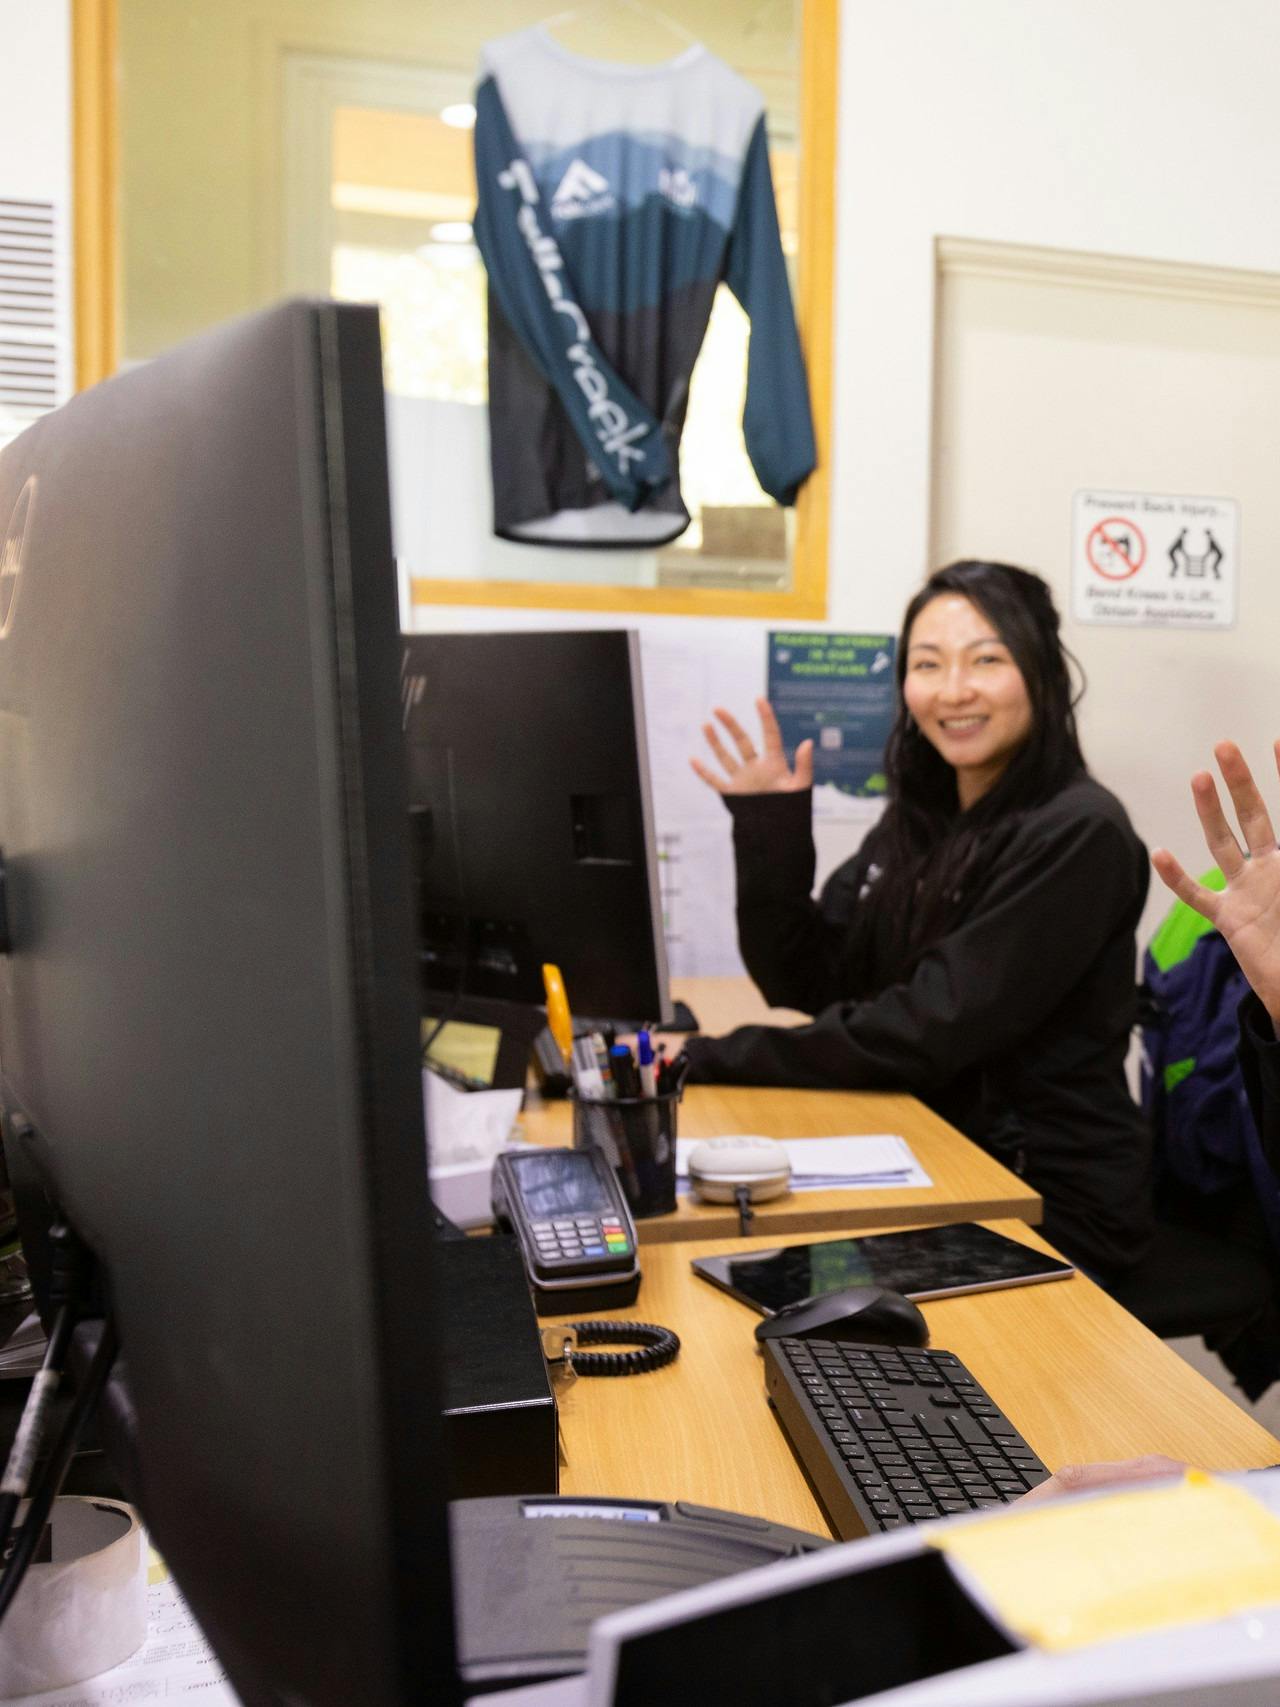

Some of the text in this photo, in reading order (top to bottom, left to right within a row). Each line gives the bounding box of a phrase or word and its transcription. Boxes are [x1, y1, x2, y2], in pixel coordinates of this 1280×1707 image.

[1084, 496, 1137, 511] Prevent
[1143, 499, 1175, 513] Back
[1085, 585, 1121, 599] Bend
[1127, 588, 1167, 601] Knees
[1173, 590, 1185, 601] to
[1144, 607, 1216, 620] Assistance
